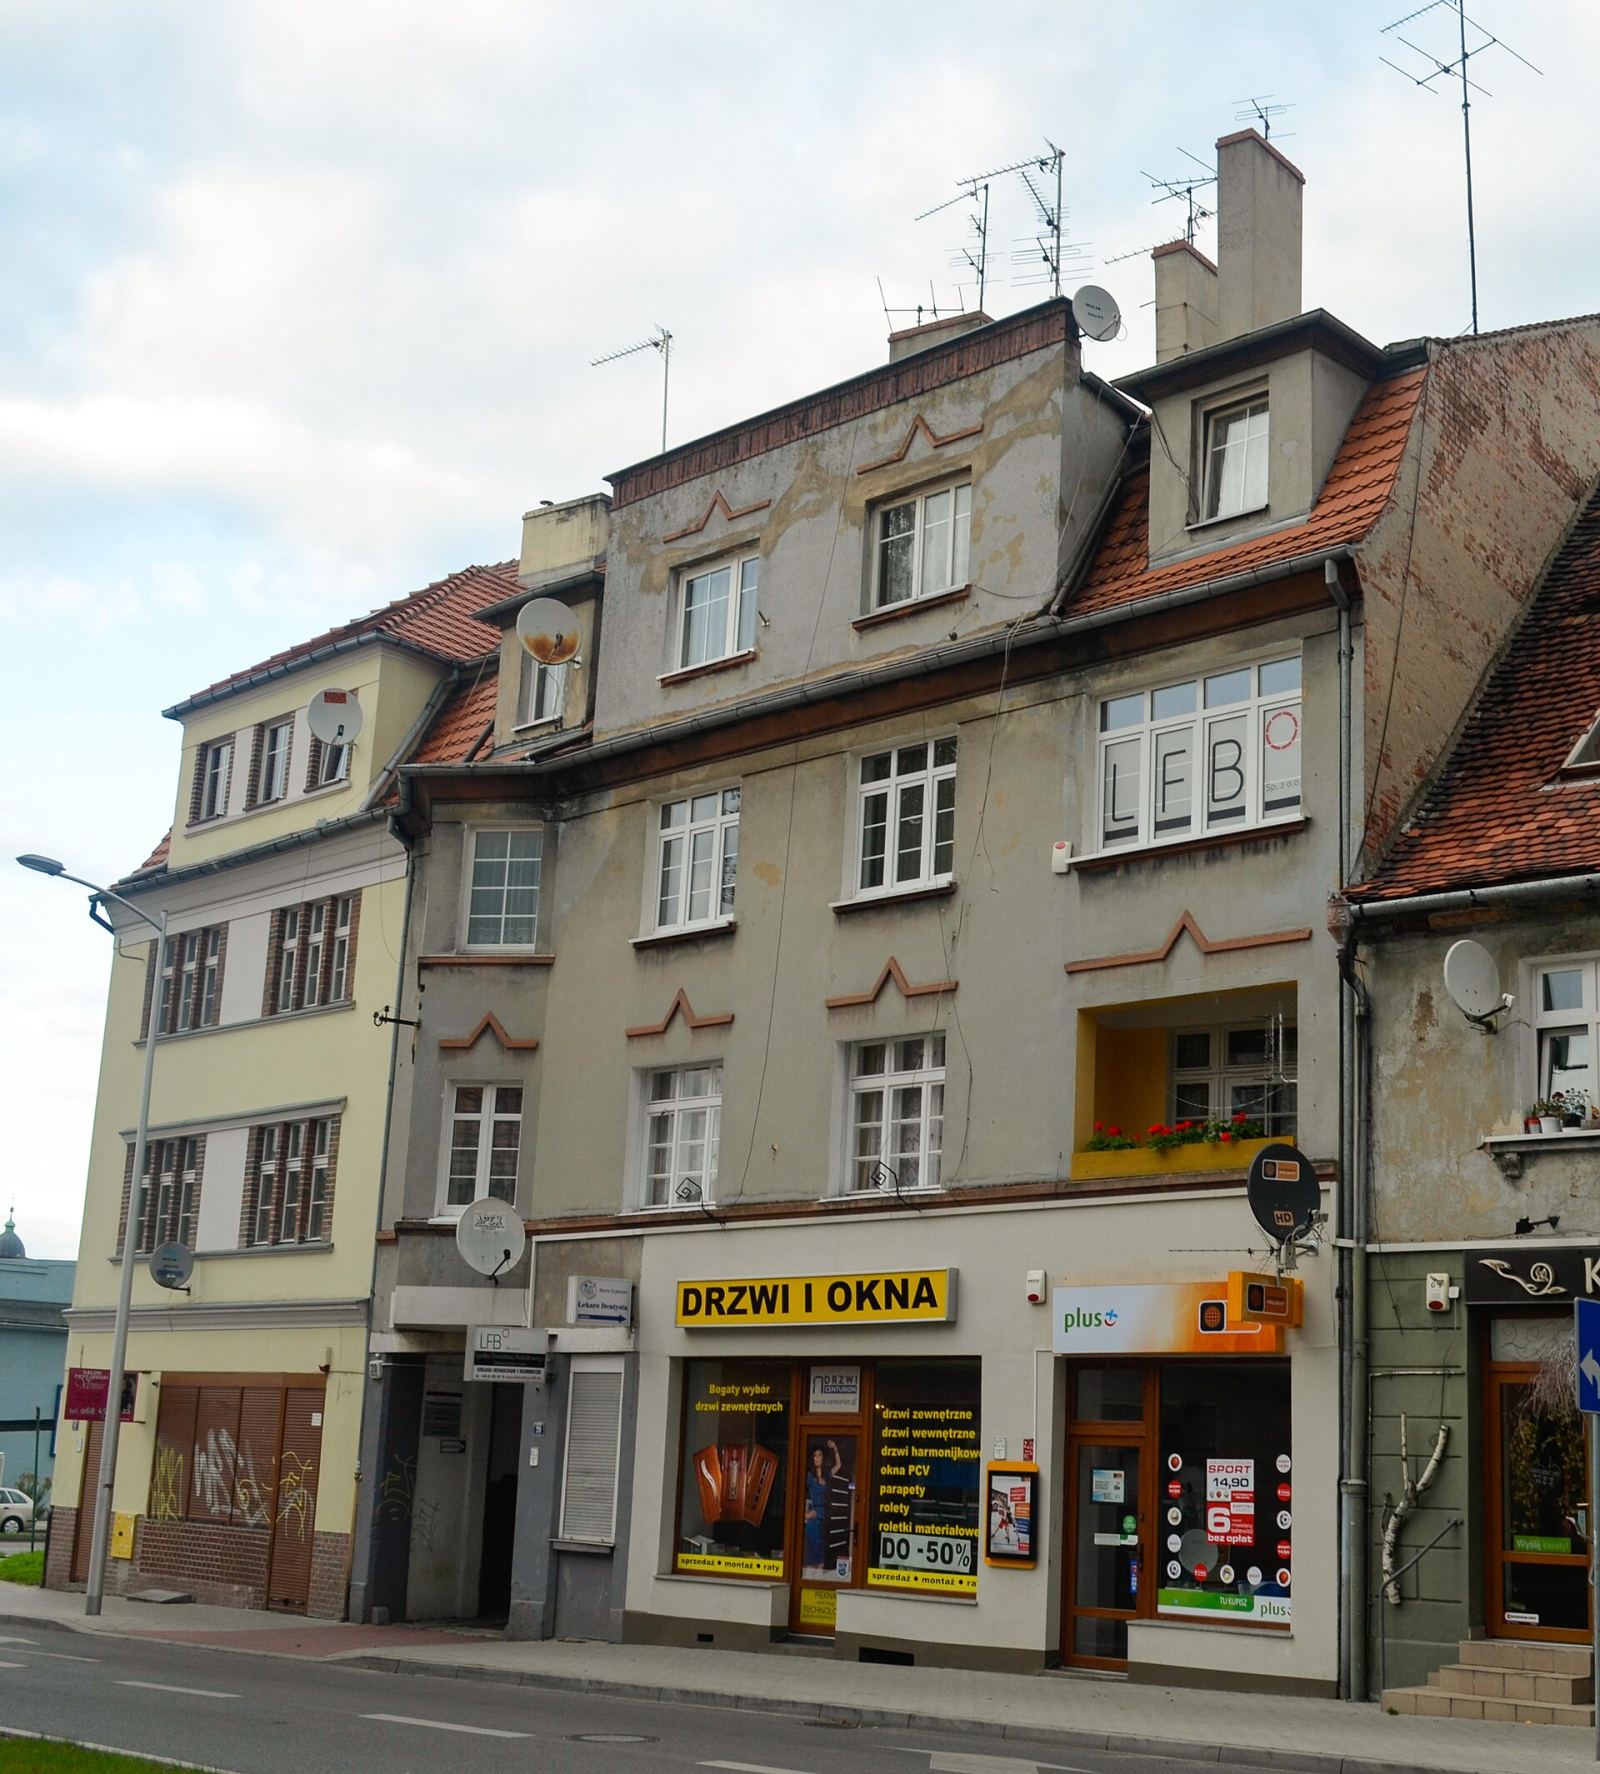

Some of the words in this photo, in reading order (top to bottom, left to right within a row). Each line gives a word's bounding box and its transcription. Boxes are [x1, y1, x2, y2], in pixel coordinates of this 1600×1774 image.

[1275, 1213, 1292, 1223] HD
[682, 1283, 789, 1317] DRZWI
[804, 1283, 813, 1313] I
[827, 1277, 938, 1313] OKNA
[1064, 1307, 1102, 1333] plus
[480, 1333, 502, 1350] LFB
[824, 1375, 858, 1385] DRZWI
[709, 1384, 740, 1396] Bogaty
[742, 1384, 771, 1396] wybór
[695, 1401, 719, 1411] drzwi
[721, 1402, 783, 1414] zewnętrznych
[882, 1408, 910, 1419] drzwi
[912, 1409, 973, 1422] zewnętrzne
[881, 1427, 909, 1438] drzwi
[912, 1428, 976, 1441] wewnętrzne
[881, 1445, 909, 1456] drzwi
[880, 1464, 905, 1476] okna
[908, 1464, 930, 1476] PCV
[1208, 1465, 1252, 1474] SPORT
[1213, 1477, 1249, 1489] 14,90
[880, 1484, 925, 1498] parapety
[879, 1502, 910, 1516] rolety
[879, 1521, 912, 1533] roletki
[1207, 1507, 1231, 1534] 6
[1207, 1533, 1226, 1542] bez
[882, 1537, 910, 1560] DO
[917, 1540, 970, 1567] -50%
[681, 1558, 715, 1567] sprzedaż
[724, 1561, 753, 1569] montaż
[763, 1564, 780, 1573] raty
[872, 1572, 911, 1582] sprzedaż
[922, 1575, 955, 1585] montaż
[1220, 1596, 1228, 1605] TU
[1260, 1602, 1286, 1617] plus
